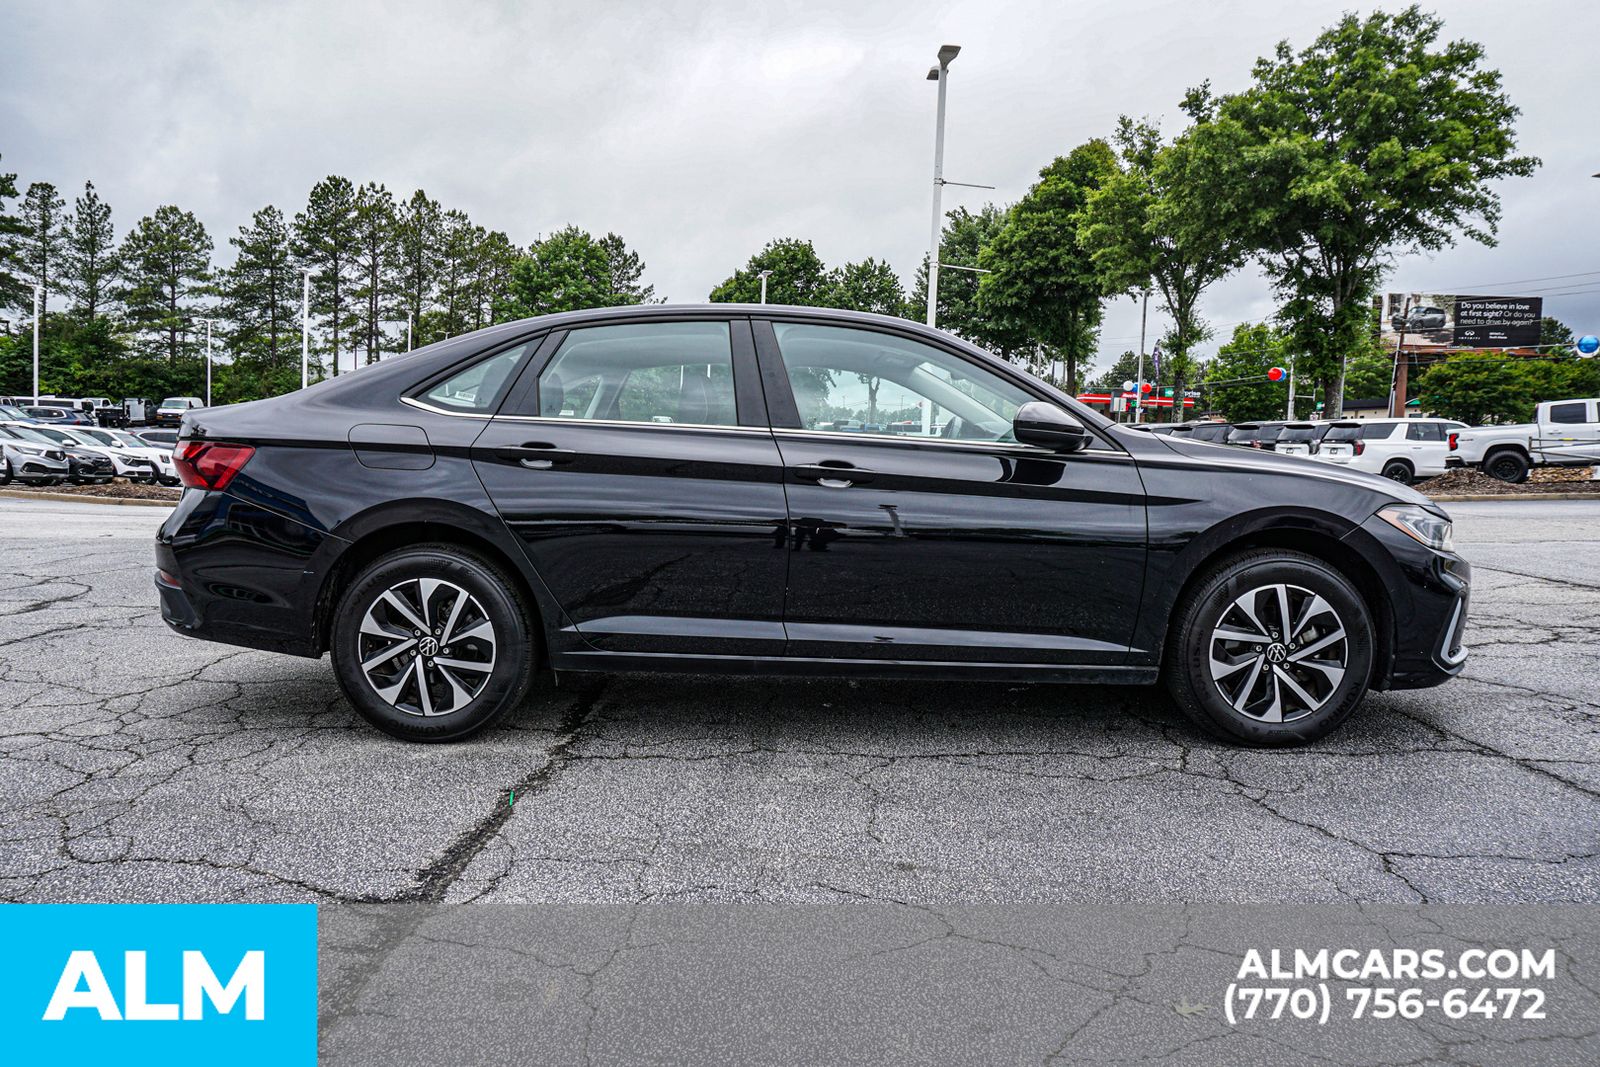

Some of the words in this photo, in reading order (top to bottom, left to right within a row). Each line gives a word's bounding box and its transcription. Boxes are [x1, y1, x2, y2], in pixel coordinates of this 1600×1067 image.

[1486, 302, 1508, 310] believe
[1483, 310, 1502, 318] sight?
[1503, 318, 1510, 326] by
[1319, 682, 1360, 727] KUMHO
